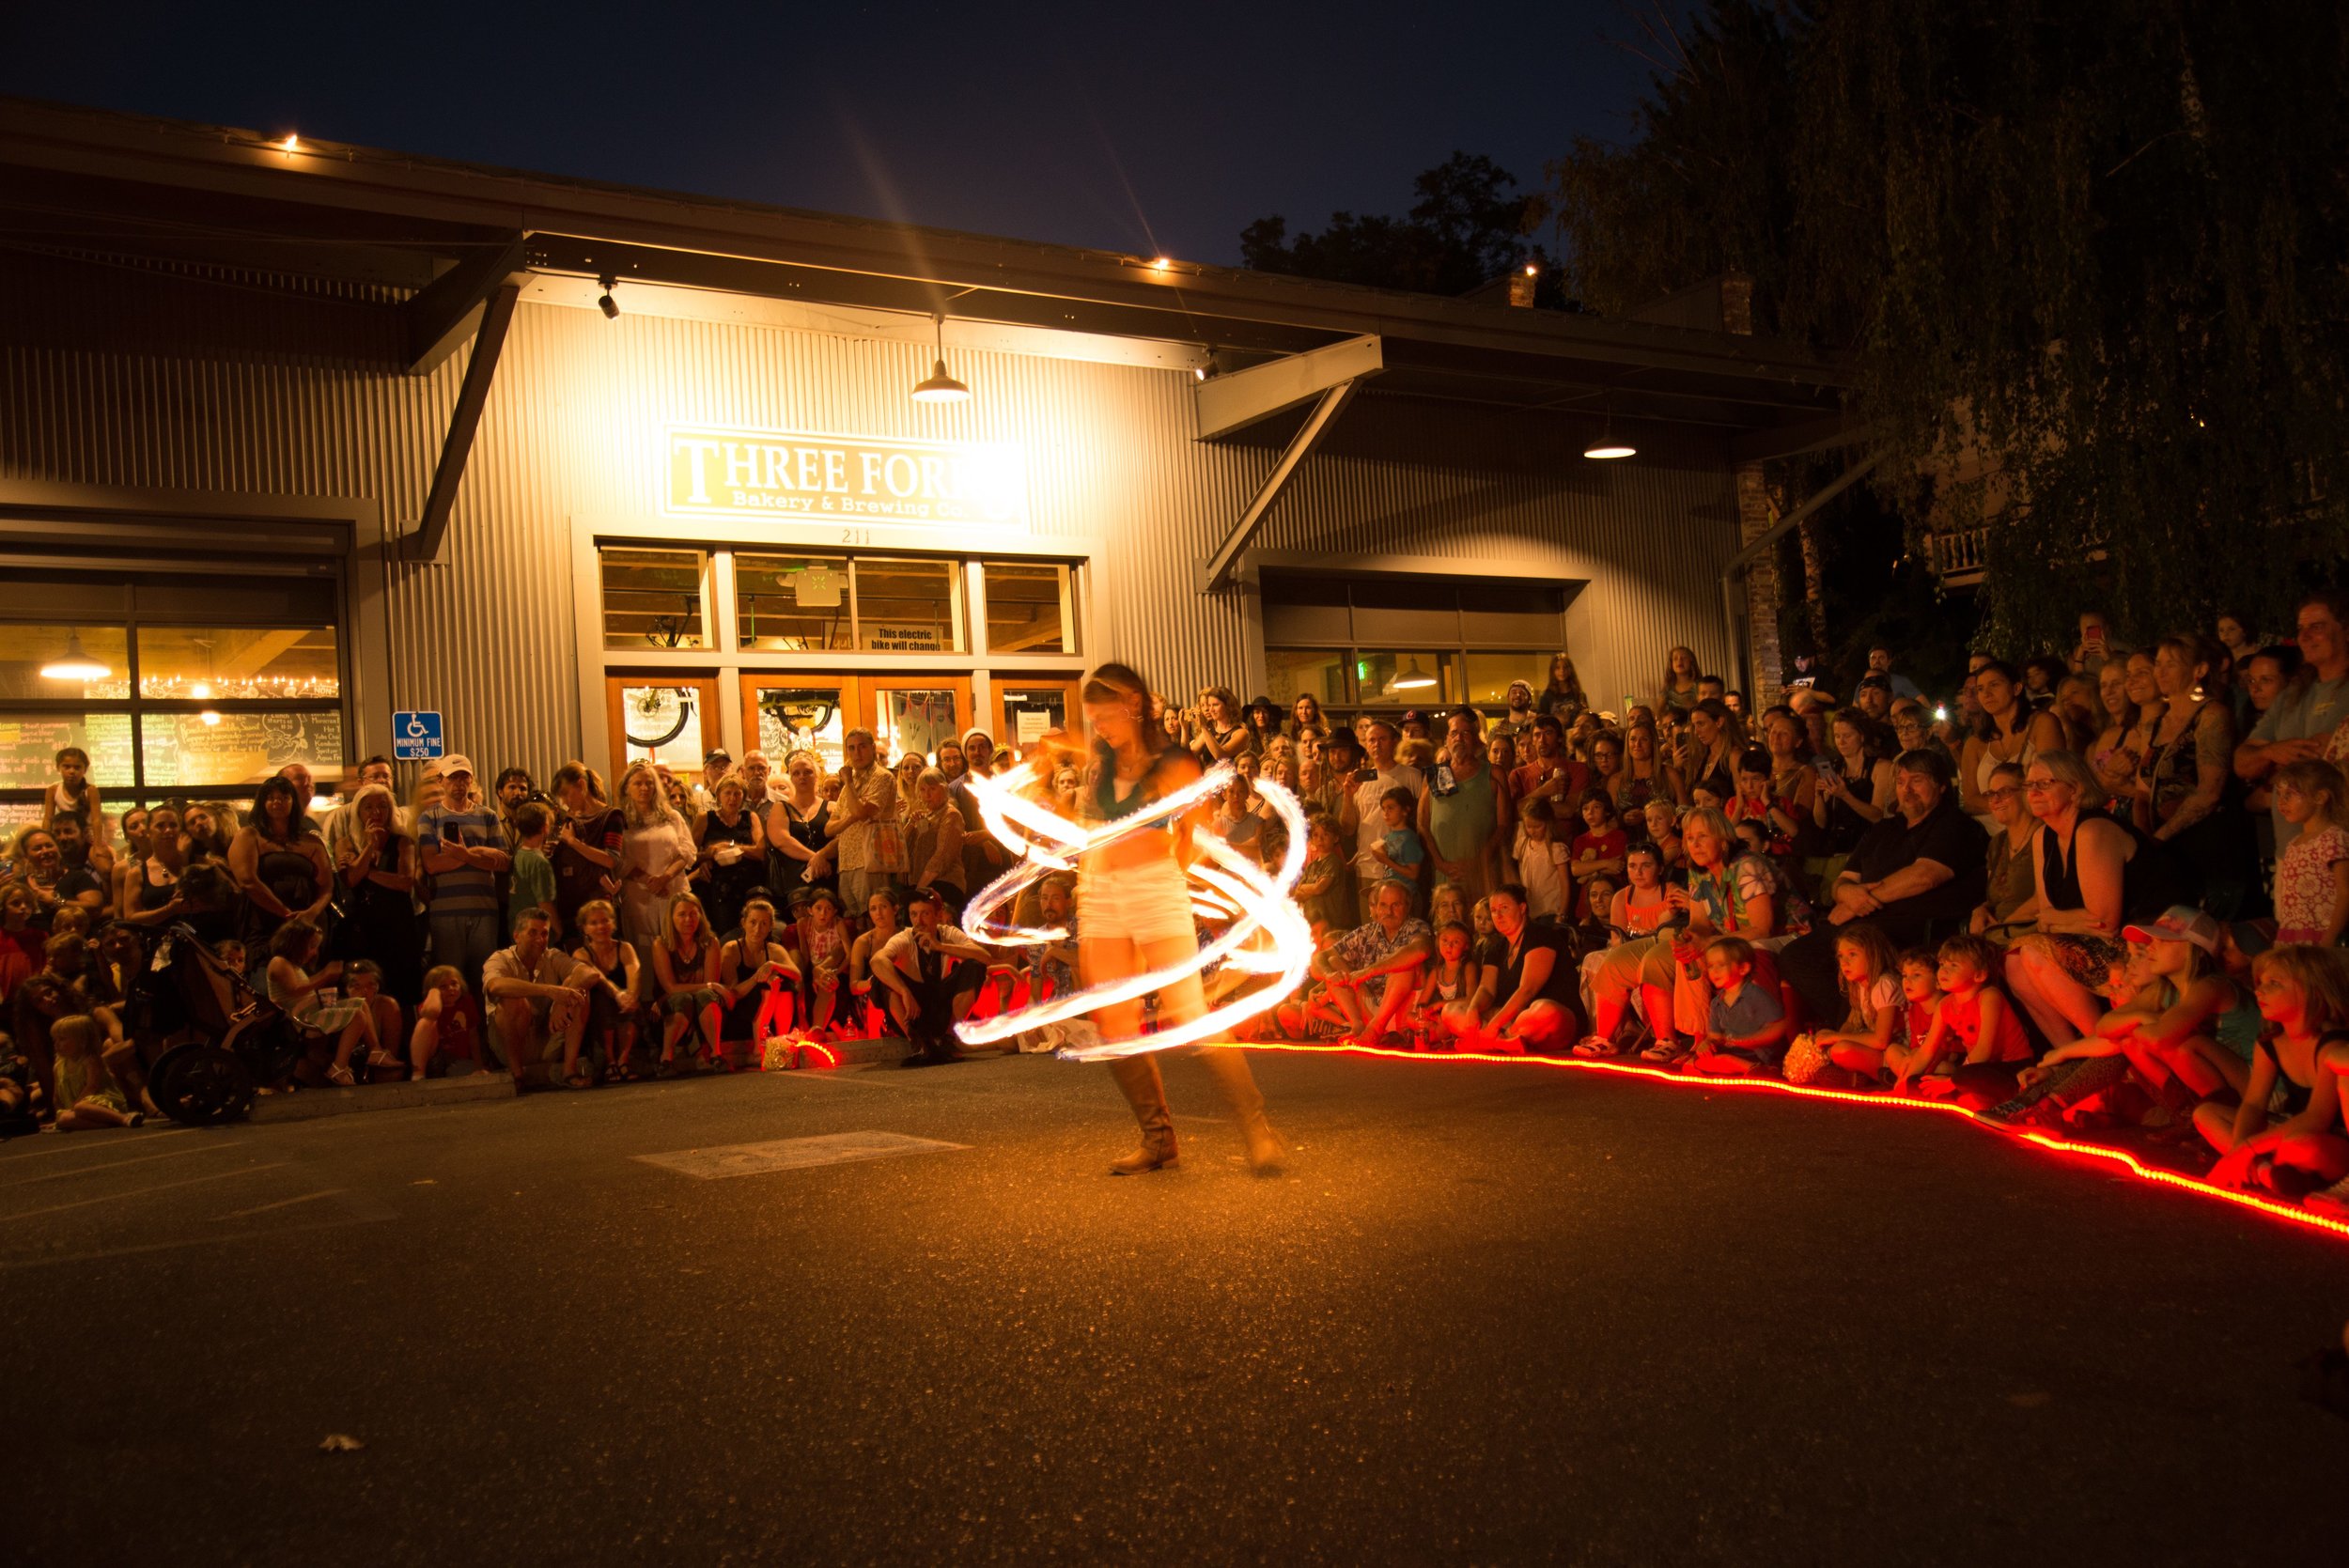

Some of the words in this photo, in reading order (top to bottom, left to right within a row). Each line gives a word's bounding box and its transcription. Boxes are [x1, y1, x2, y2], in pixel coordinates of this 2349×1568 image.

[673, 438, 849, 505] THREE
[732, 489, 815, 513] Bakery
[821, 495, 834, 511] &
[841, 496, 930, 519] Brewing
[841, 528, 871, 546] 211
[879, 628, 896, 639] This
[898, 629, 932, 640] electric
[871, 639, 890, 650] bike
[892, 640, 908, 651] will
[909, 641, 941, 652] change
[397, 737, 424, 747] MINIMUM
[427, 737, 441, 747] FINE
[410, 747, 429, 757] $250
